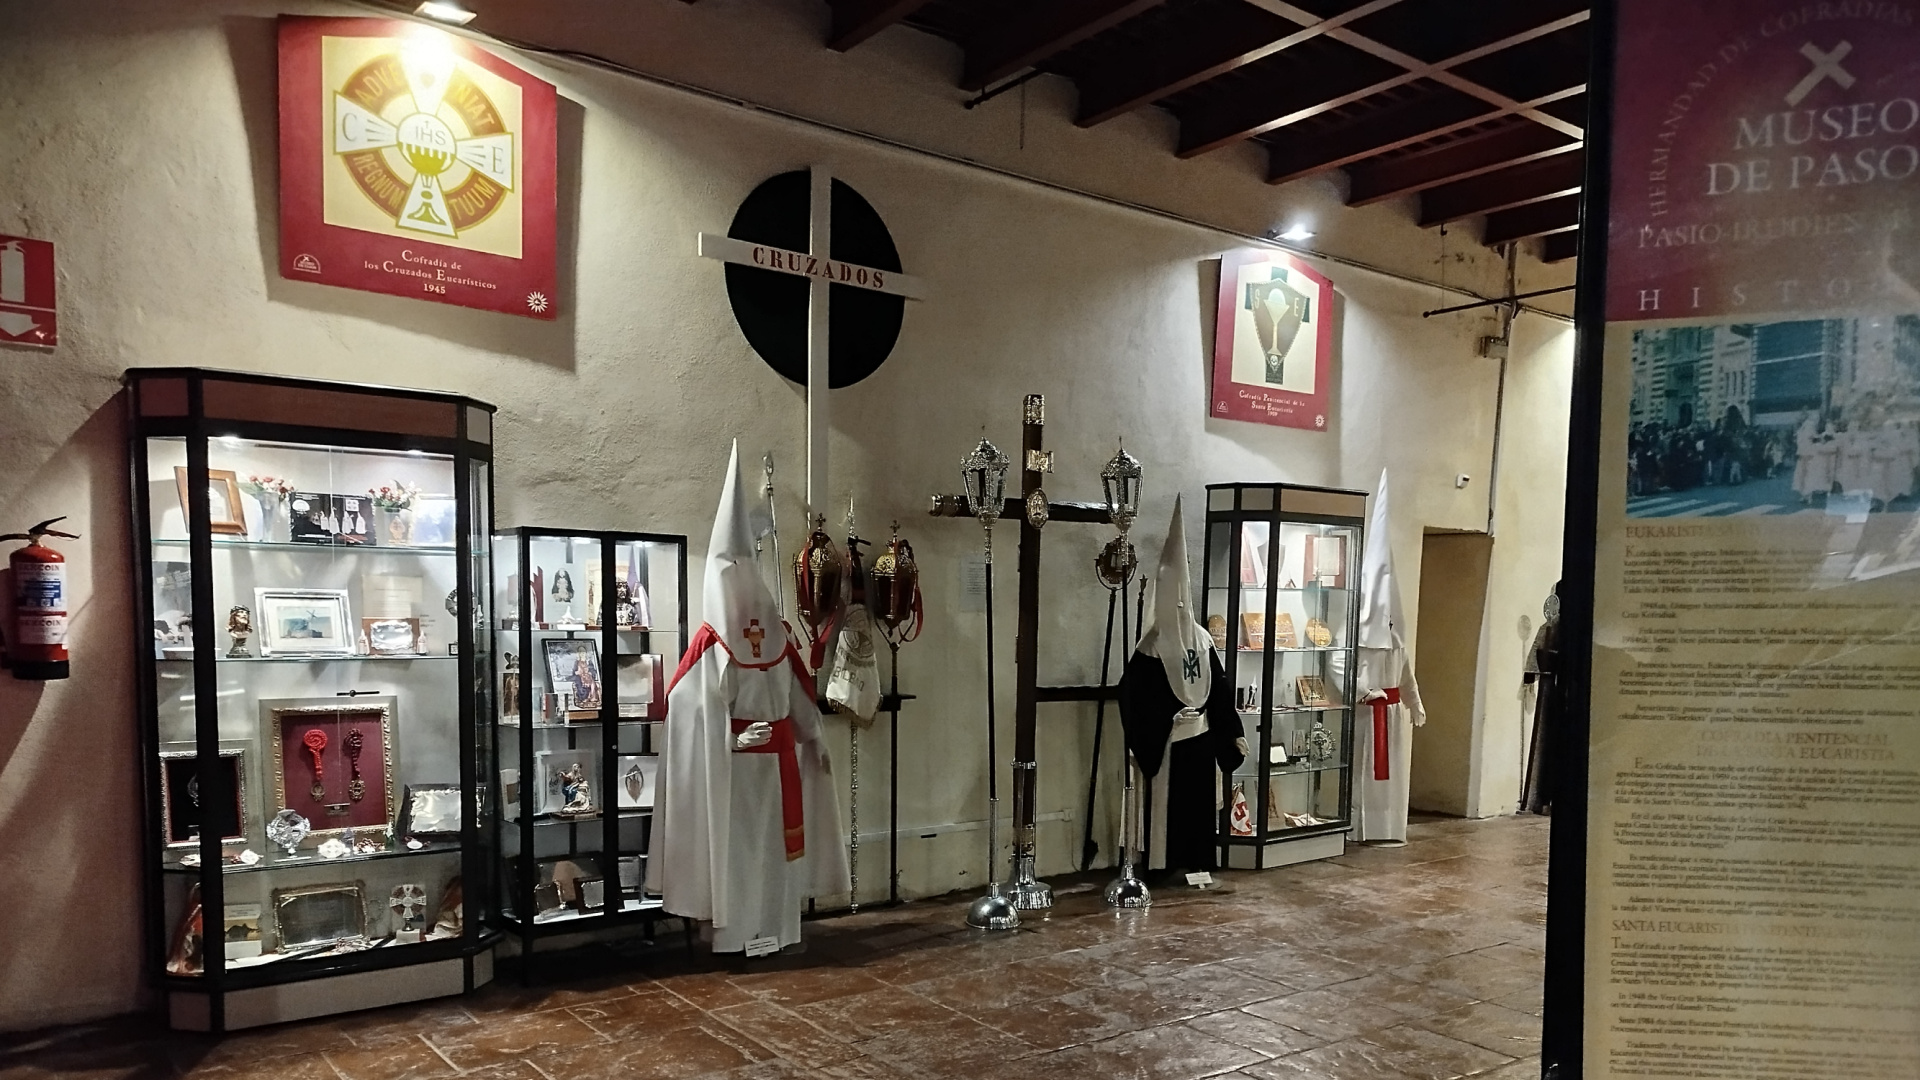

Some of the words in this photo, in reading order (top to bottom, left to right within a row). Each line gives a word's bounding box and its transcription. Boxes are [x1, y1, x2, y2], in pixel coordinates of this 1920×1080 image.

[342, 113, 357, 141] C
[415, 125, 446, 146] IHS
[1733, 97, 1919, 150] MUSEO
[492, 146, 504, 174] E
[353, 154, 405, 208] REGNUM
[1706, 159, 1772, 196] DE
[449, 178, 497, 220] TUUM
[401, 250, 447, 268] Cofradía
[451, 262, 462, 270] de
[752, 246, 885, 289] CRUZADOS
[364, 261, 379, 270] los
[383, 261, 432, 279] Cruzados
[436, 269, 497, 290] Eucarísticos
[423, 283, 446, 294] 1945
[1611, 920, 1656, 932] SANTA
